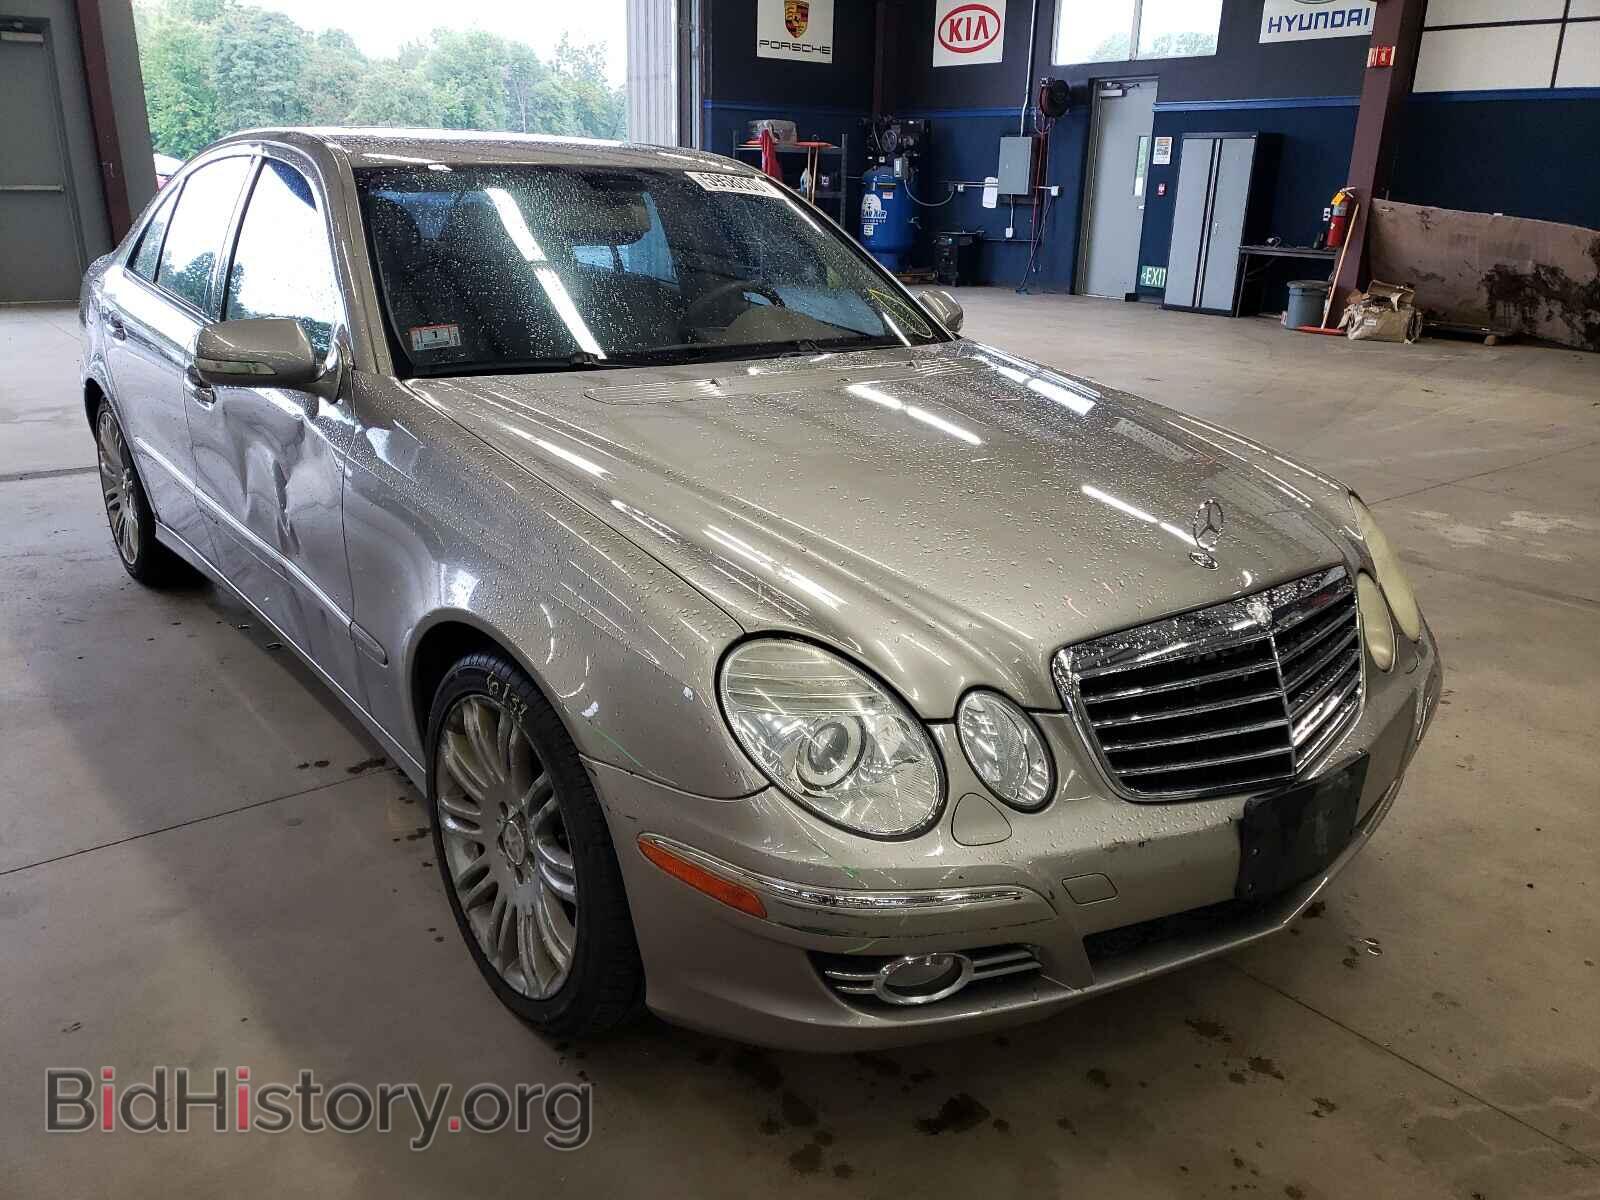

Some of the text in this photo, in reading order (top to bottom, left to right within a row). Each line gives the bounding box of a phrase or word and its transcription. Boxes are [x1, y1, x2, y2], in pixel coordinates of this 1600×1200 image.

[948, 15, 990, 43] KIA
[1268, 8, 1371, 34] HYUNDAI
[759, 39, 832, 55] PORSCHE
[1145, 267, 1167, 286] EXIT
